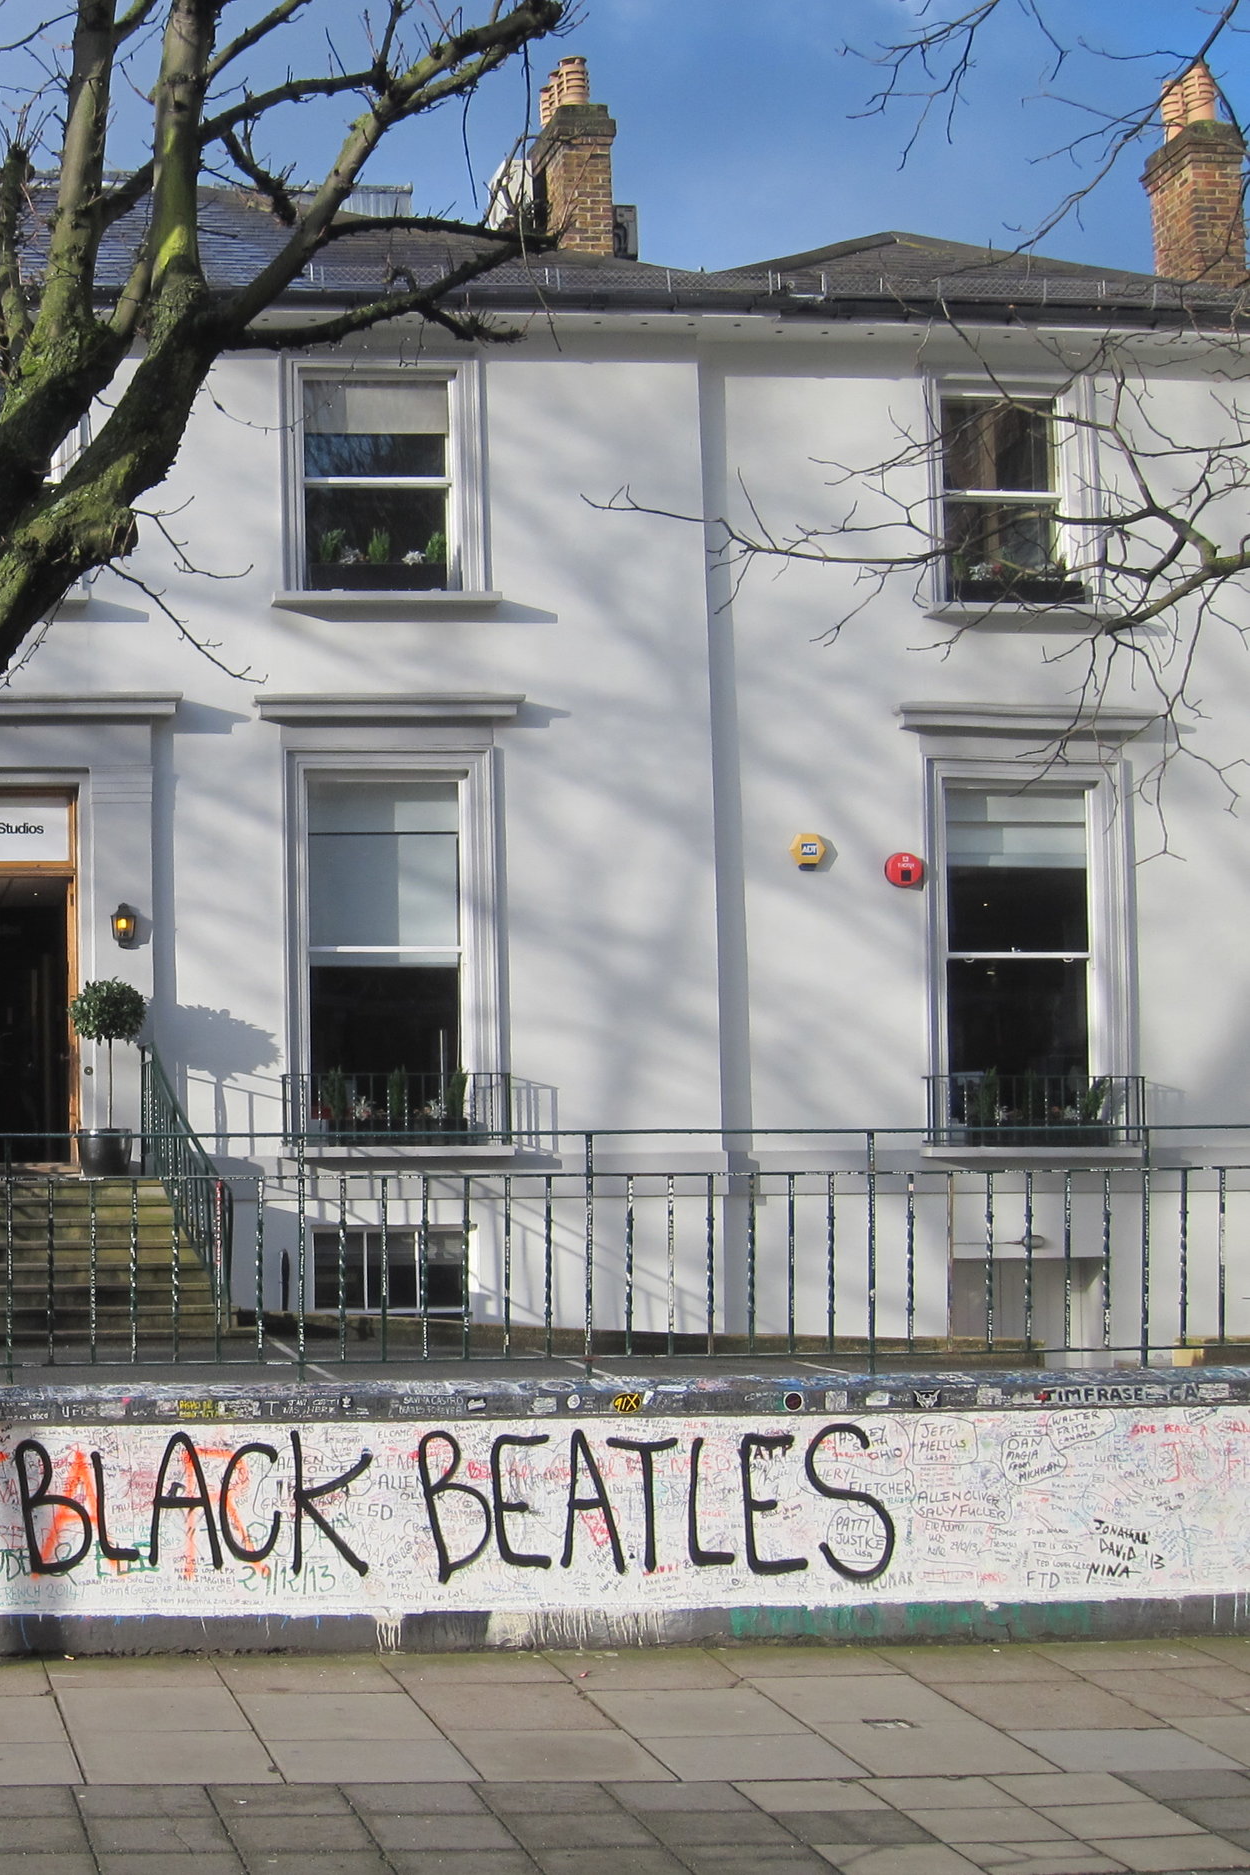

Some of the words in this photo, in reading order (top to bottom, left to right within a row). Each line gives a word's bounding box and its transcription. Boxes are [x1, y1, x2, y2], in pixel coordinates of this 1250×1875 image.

[801, 845, 818, 854] ADT
[613, 1394, 640, 1414] 91X
[1051, 1410, 1101, 1427] WALTER
[920, 1422, 954, 1439] JEFF
[1006, 1437, 1043, 1450] DAN
[1018, 1462, 1062, 1482] MICHIGAN
[15, 1431, 373, 1577] BLACK
[419, 1423, 895, 1584] BEATLES
[960, 1503, 1006, 1520] FULLER
